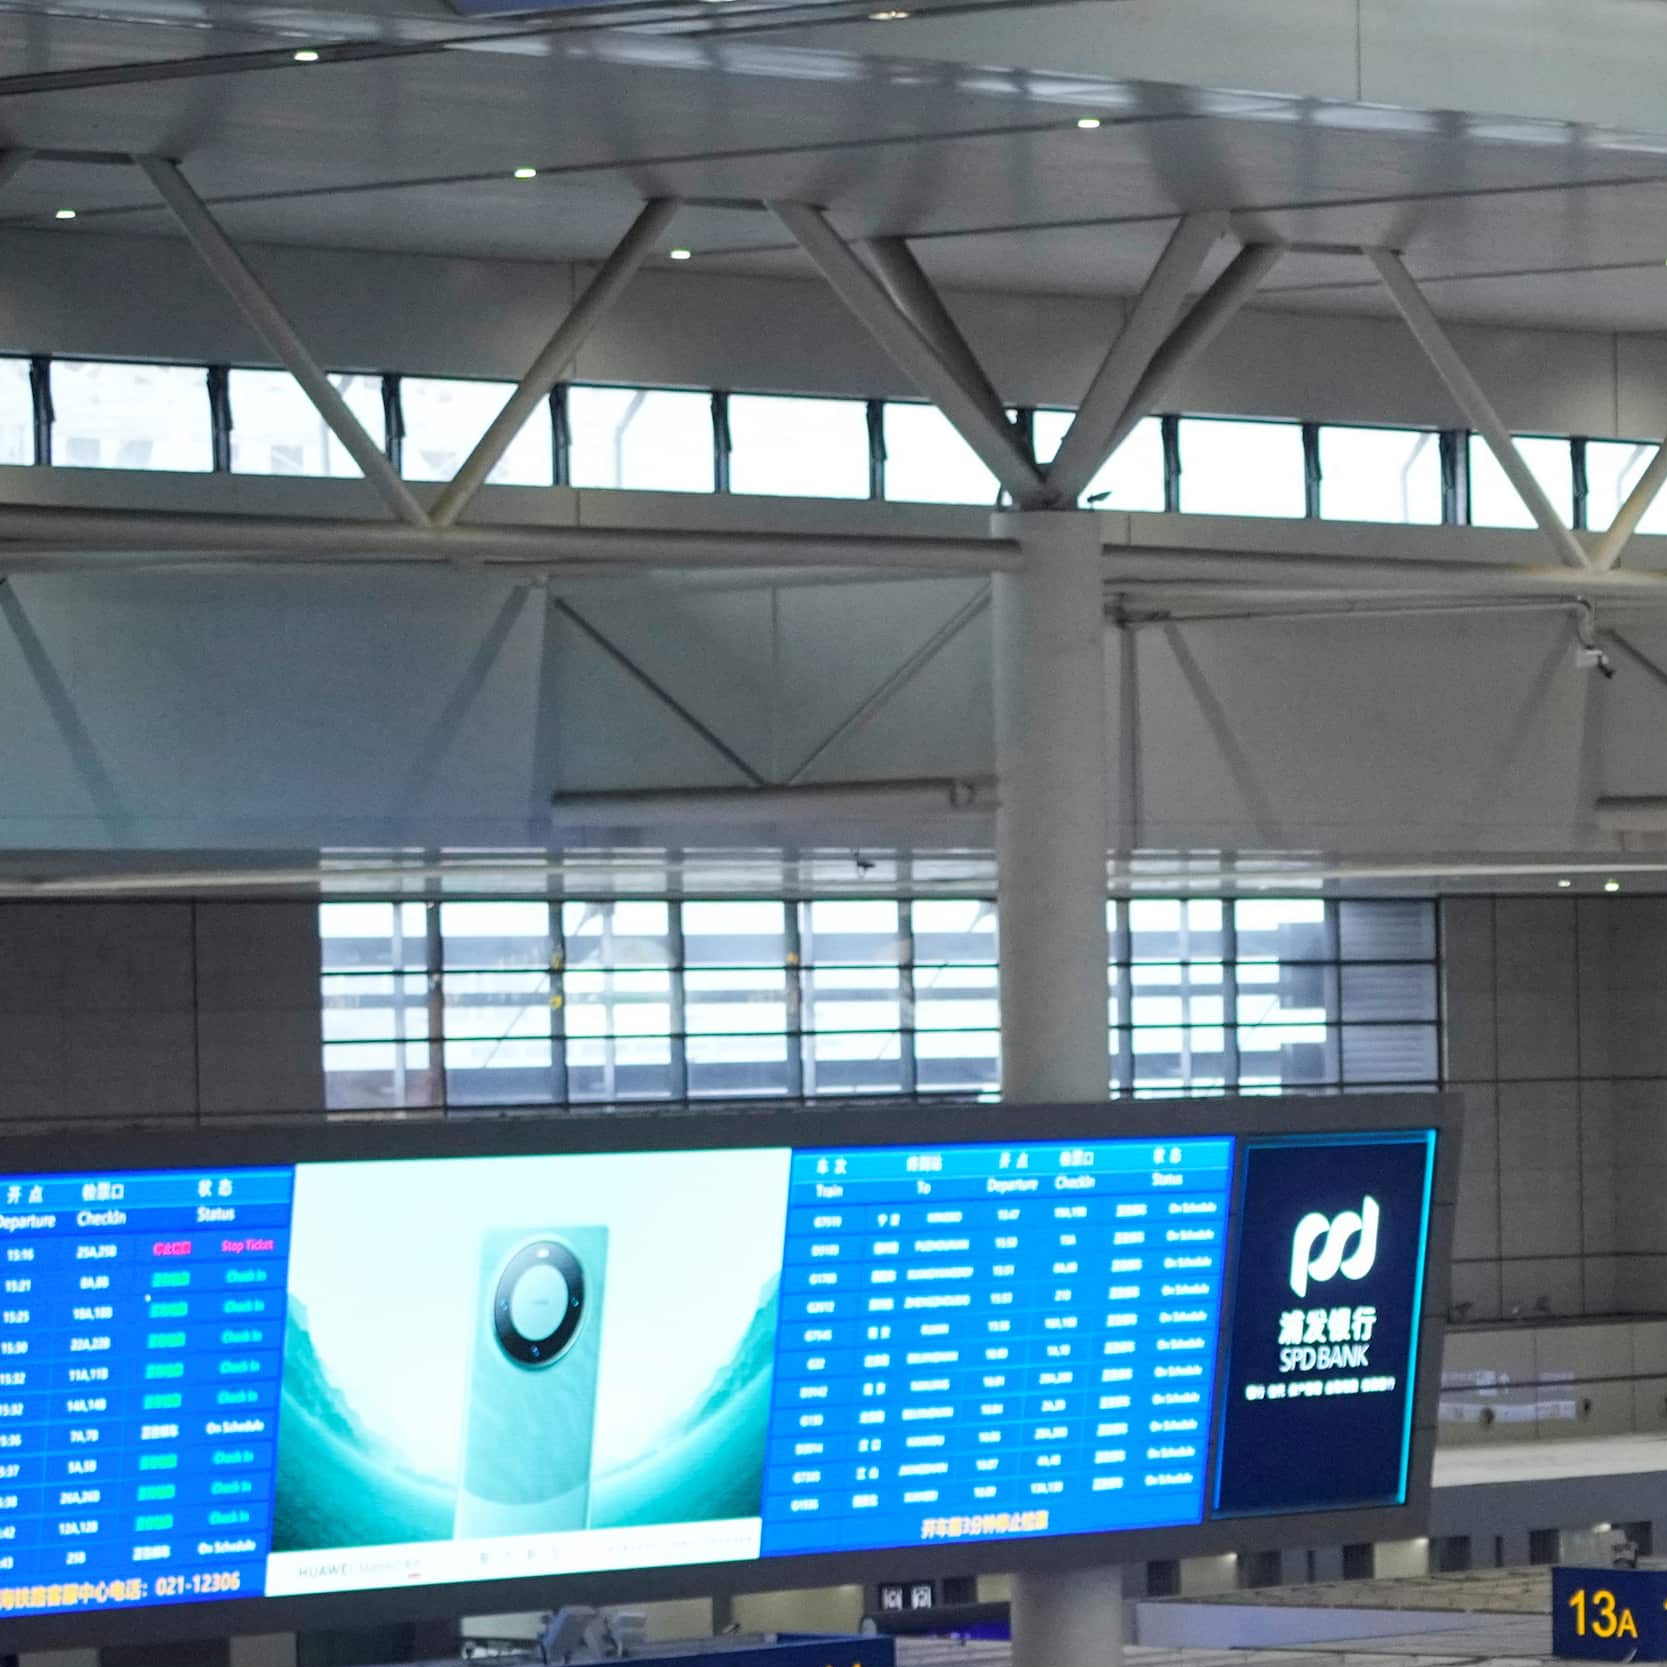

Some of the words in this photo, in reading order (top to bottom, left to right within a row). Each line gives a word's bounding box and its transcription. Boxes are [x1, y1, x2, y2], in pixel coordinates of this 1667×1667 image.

[1278, 1306, 1377, 1345] 浦发银行
[1279, 1346, 1316, 1373] SPD
[1316, 1344, 1370, 1370] BANK
[1568, 1589, 1638, 1639] 13A
